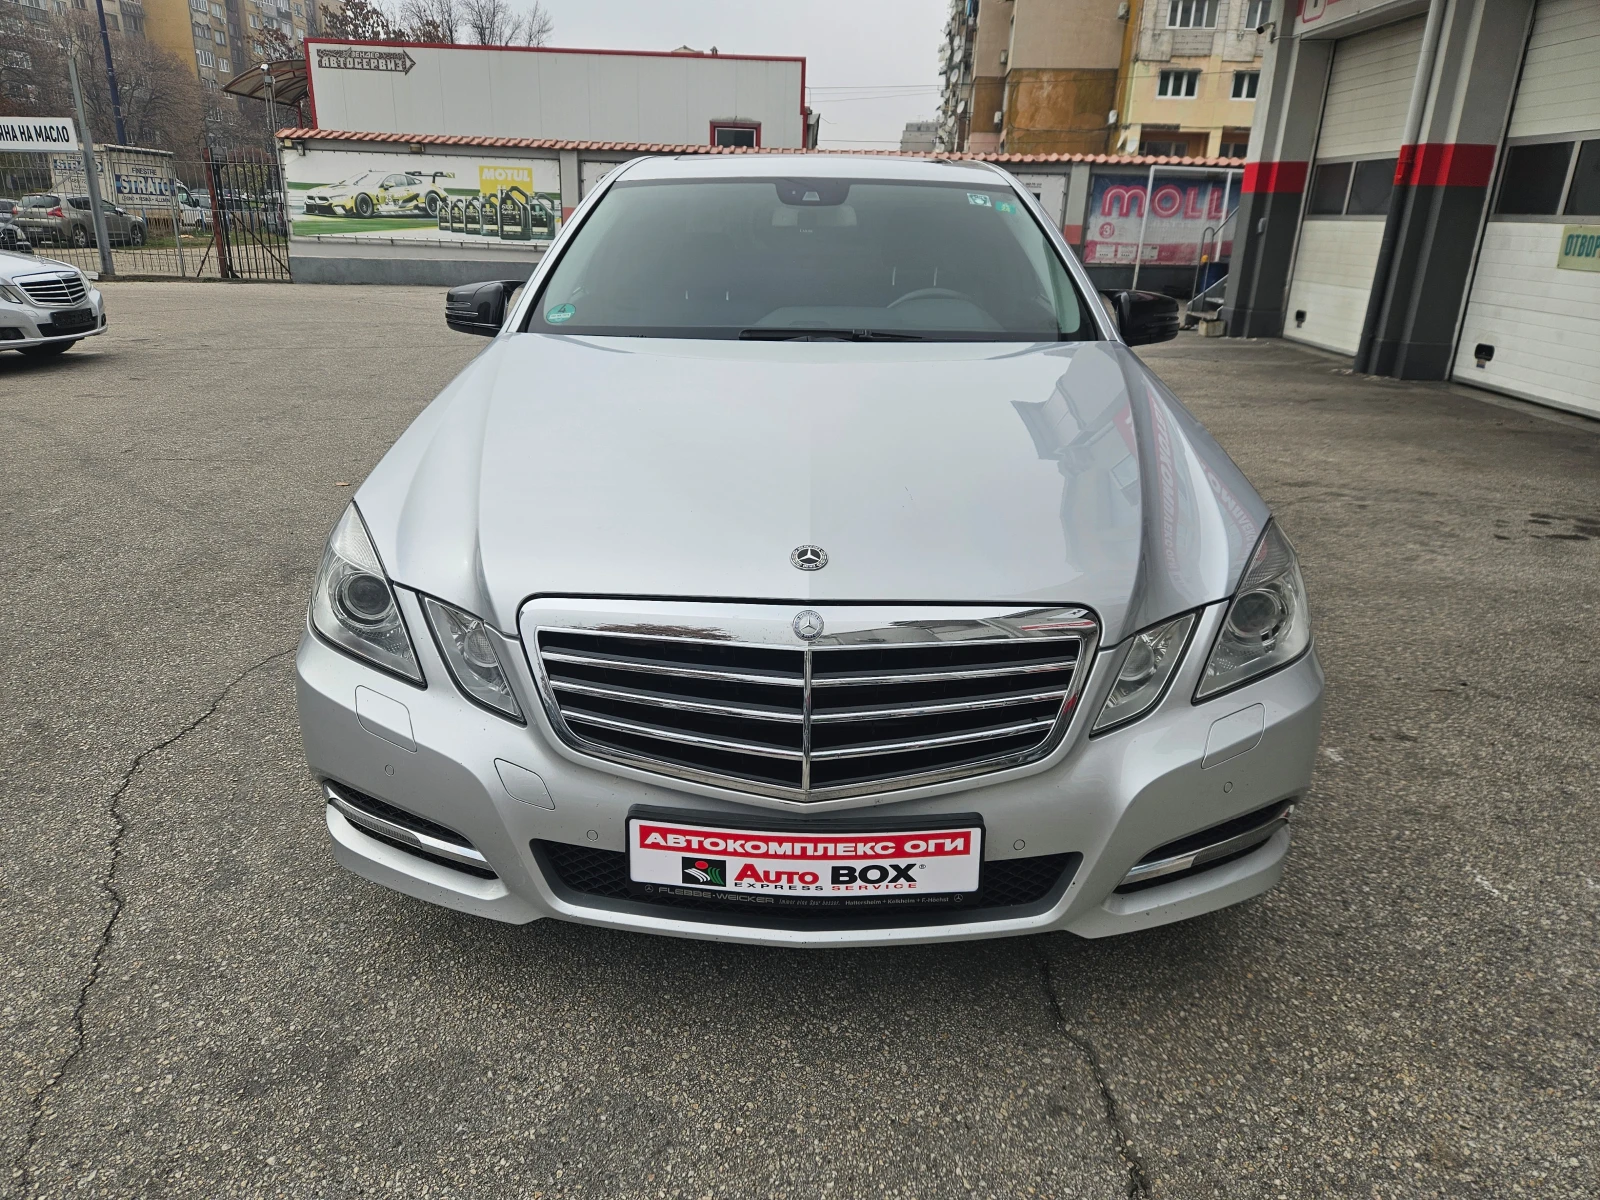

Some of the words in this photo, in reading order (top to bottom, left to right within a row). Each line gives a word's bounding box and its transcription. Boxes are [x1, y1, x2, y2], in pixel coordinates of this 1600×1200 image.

[322, 57, 402, 71] АВТОСЕРВИЗ
[18, 125, 34, 142] НА
[33, 125, 70, 143] МАСЛО
[132, 167, 157, 175] FINESTRE
[482, 168, 530, 182] MOTUL
[644, 832, 896, 856] АВТОКОМПЛЕКС
[904, 837, 965, 854] ОГИ
[734, 882, 824, 891] EXPRESS
[832, 882, 917, 891] SERVICE
